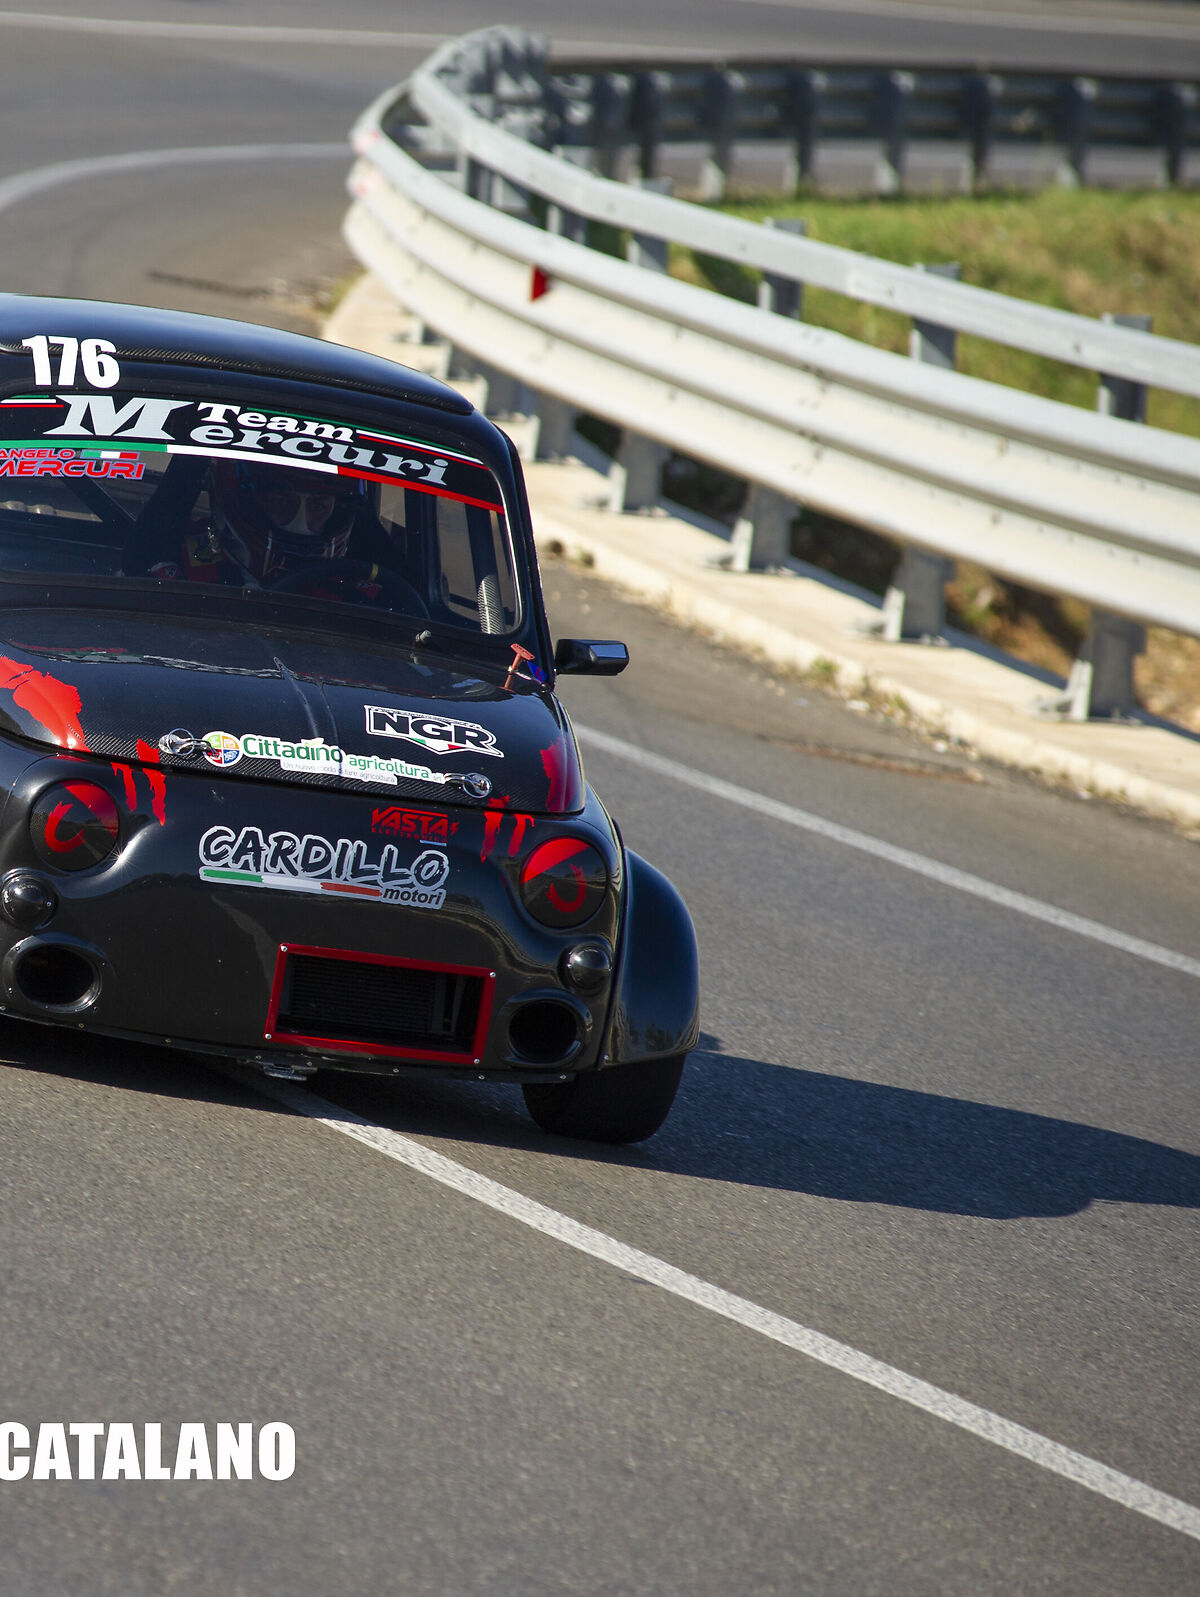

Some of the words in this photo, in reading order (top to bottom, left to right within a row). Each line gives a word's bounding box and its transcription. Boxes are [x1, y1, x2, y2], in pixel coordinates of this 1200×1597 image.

[21, 335, 120, 389] 176
[197, 402, 355, 443] Team
[373, 711, 490, 749] NGR
[243, 737, 343, 763] Cittadino
[349, 755, 430, 779] agricoltura
[371, 806, 448, 838] VASTA
[202, 827, 448, 889] CARDILLO
[383, 886, 443, 906] motori
